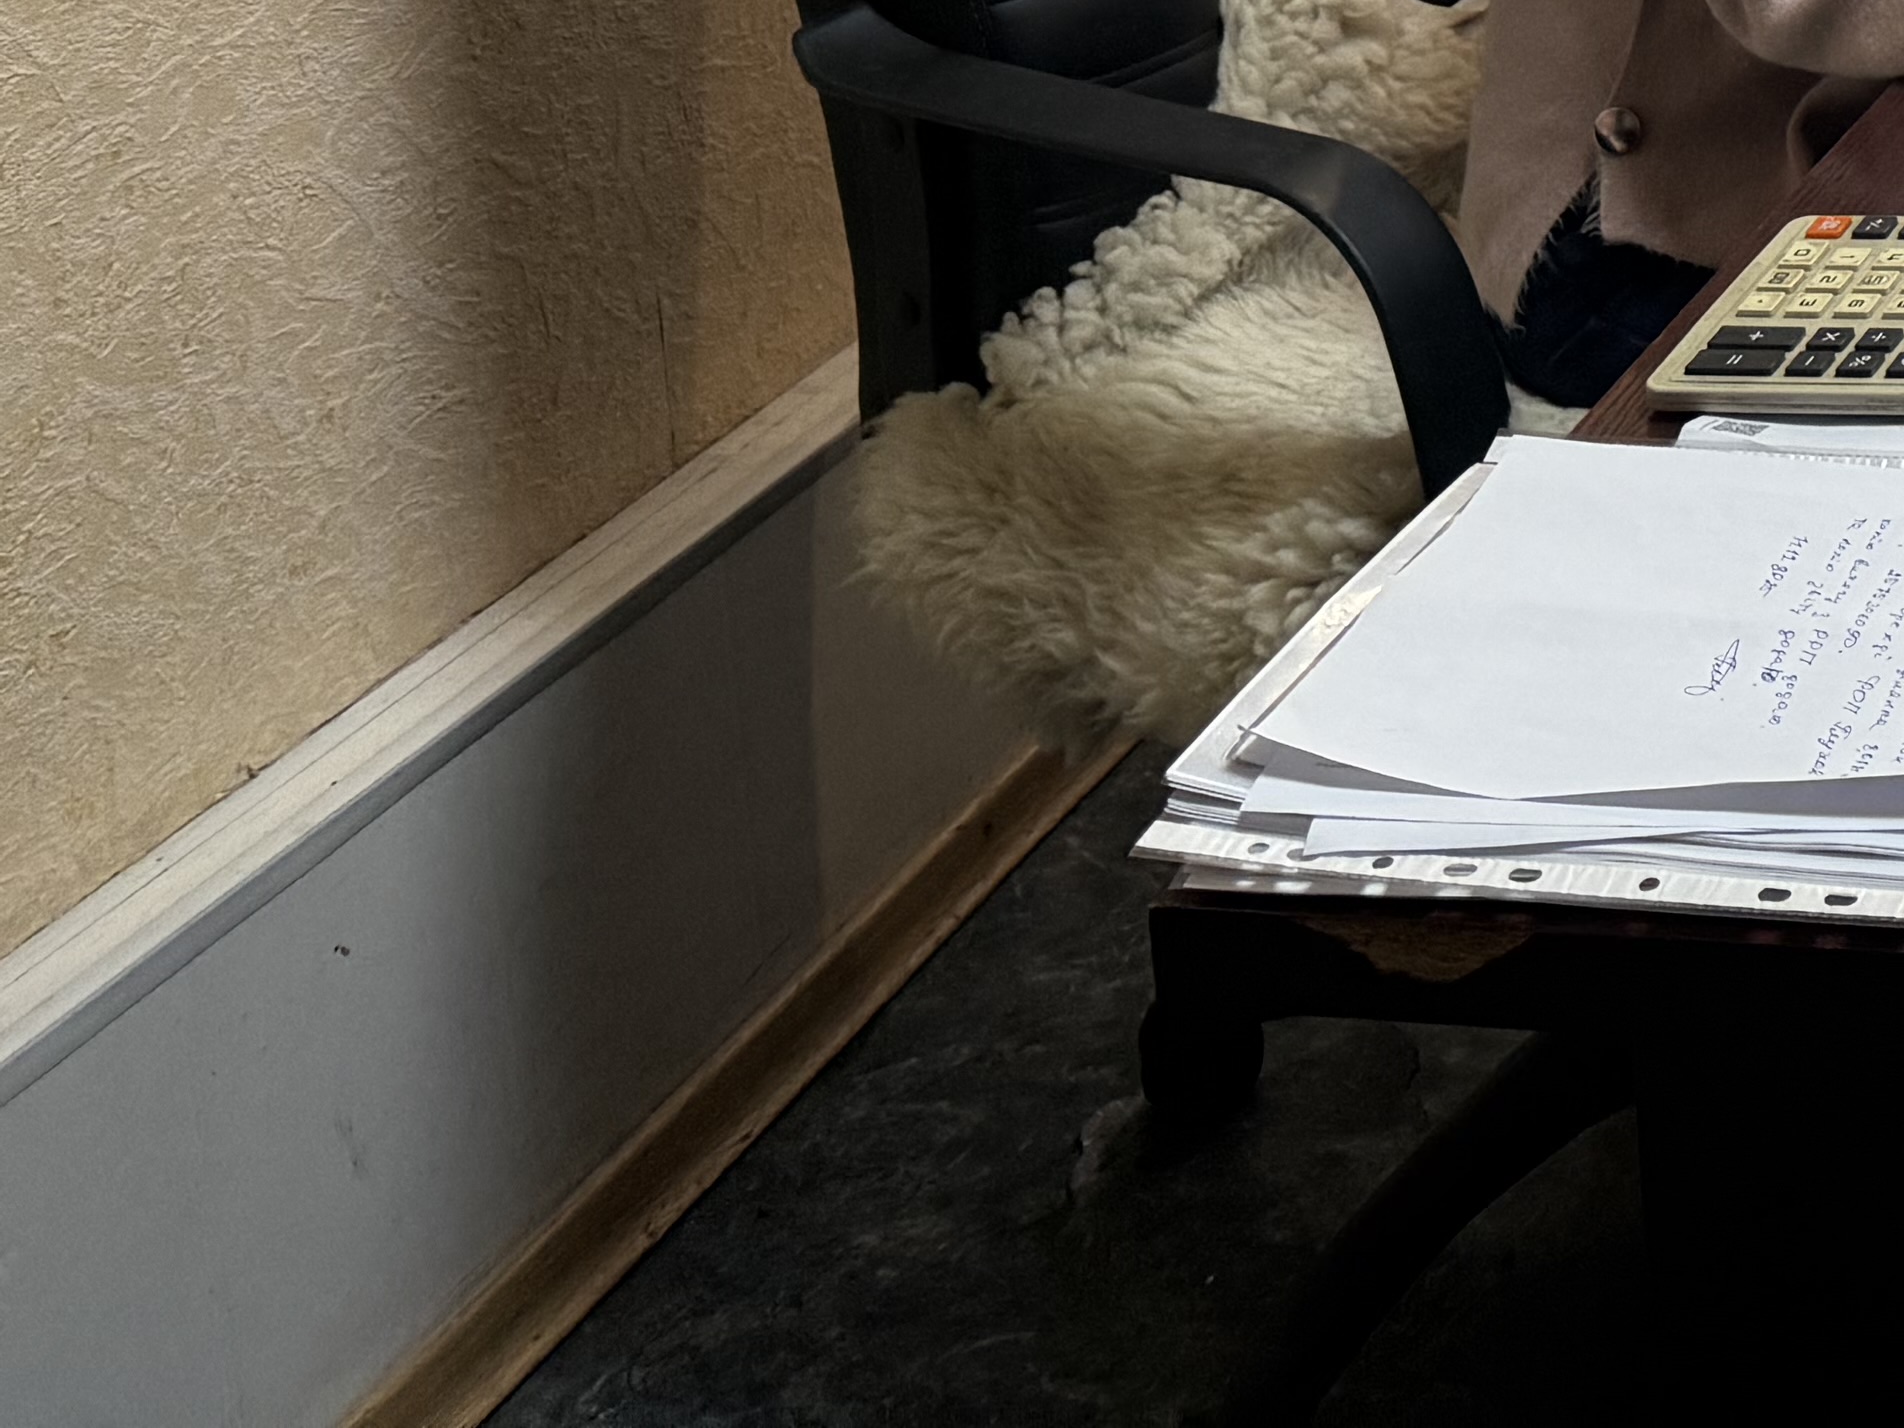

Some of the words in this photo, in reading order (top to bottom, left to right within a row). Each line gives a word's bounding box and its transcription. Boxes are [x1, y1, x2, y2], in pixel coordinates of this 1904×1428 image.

[1793, 248, 1811, 257] 0
[1887, 252, 1904, 261] 4
[1819, 275, 1838, 283] 2
[1799, 298, 1818, 307] 3
[1848, 299, 1865, 308] 6
[1842, 674, 1882, 716] ФОП
